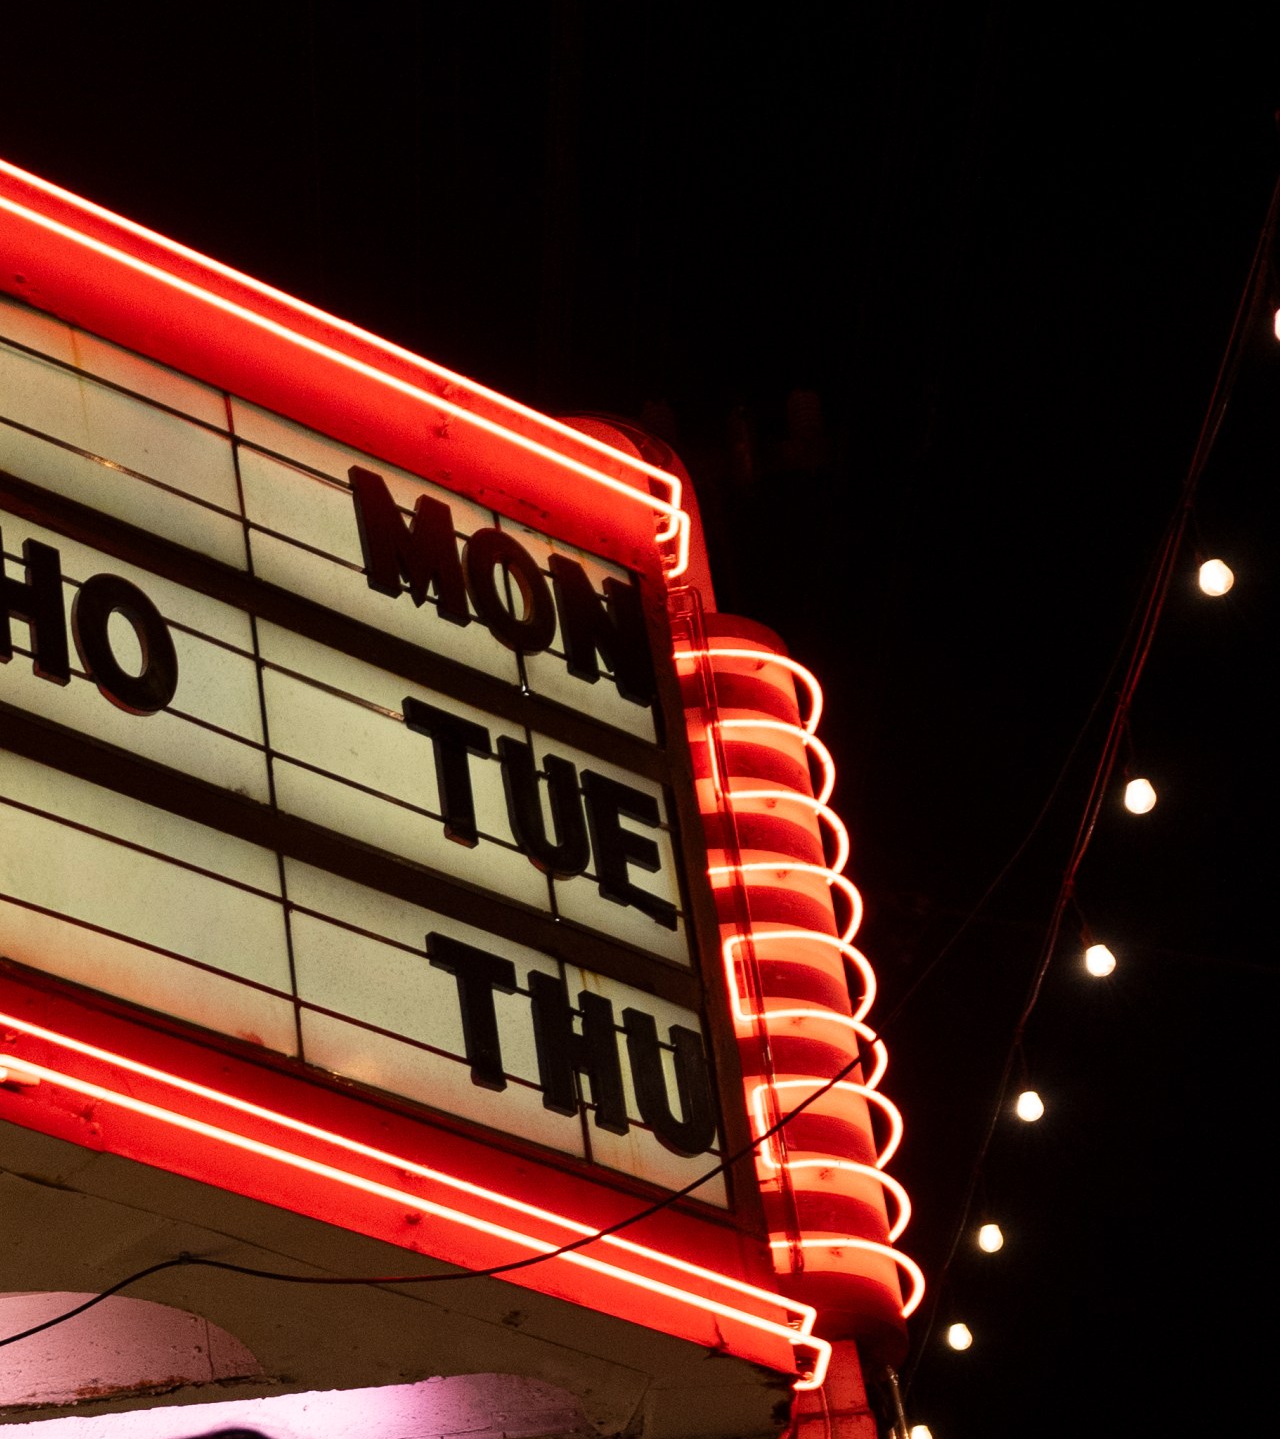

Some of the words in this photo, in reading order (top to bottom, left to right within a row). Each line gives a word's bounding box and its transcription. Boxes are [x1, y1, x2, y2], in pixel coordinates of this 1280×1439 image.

[348, 464, 654, 707] MON
[402, 696, 678, 931] TUE
[425, 931, 717, 1158] THU
